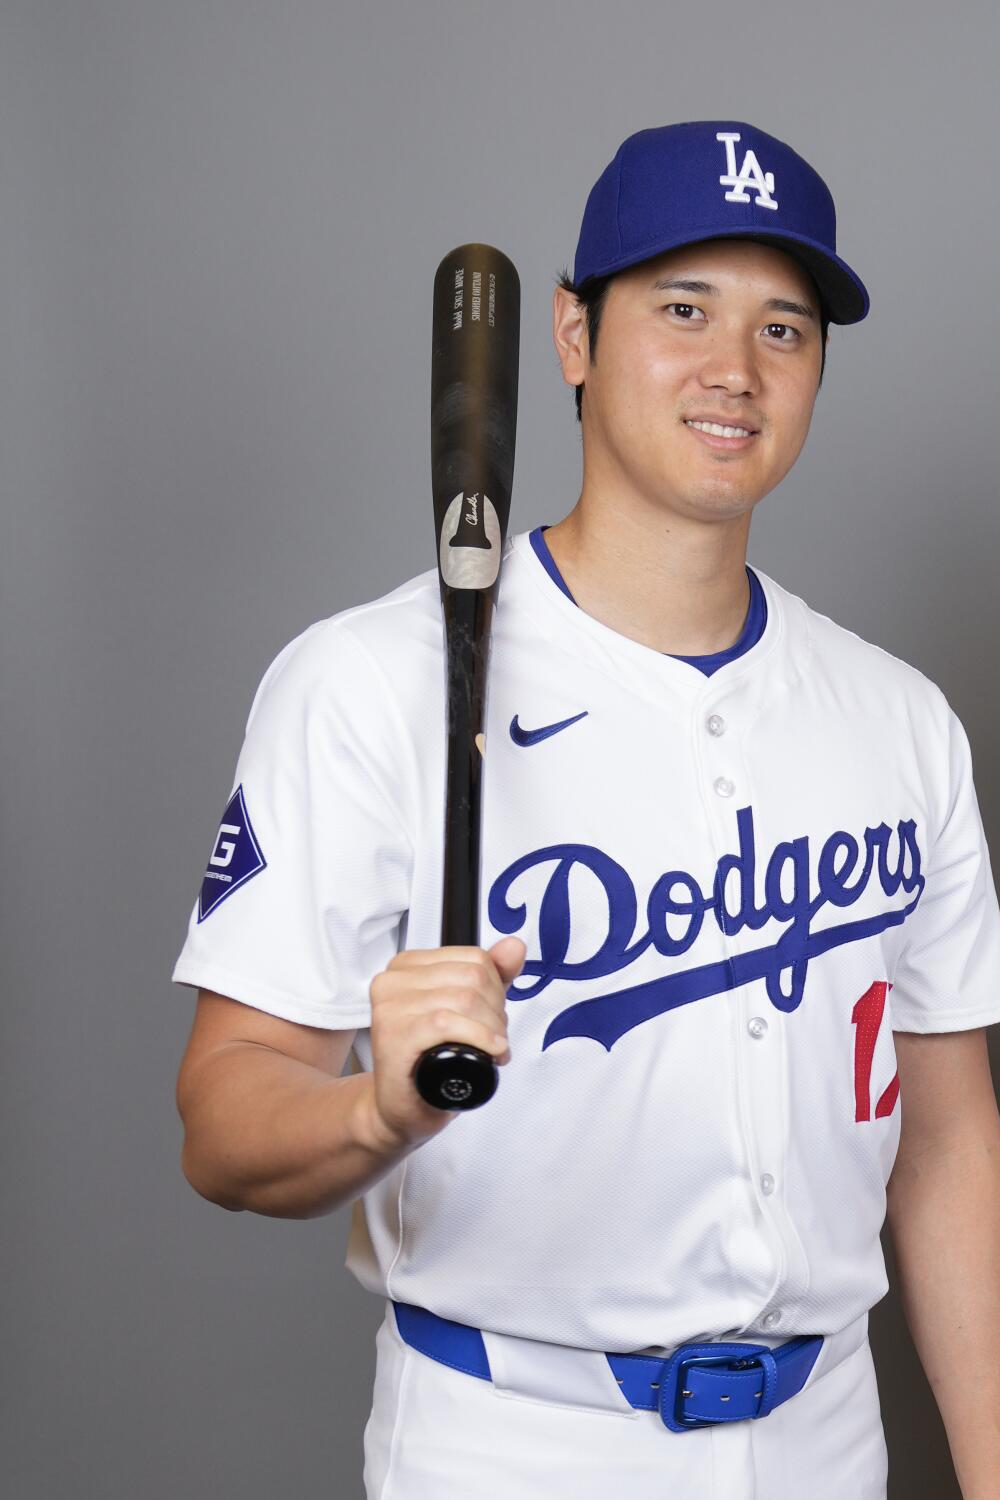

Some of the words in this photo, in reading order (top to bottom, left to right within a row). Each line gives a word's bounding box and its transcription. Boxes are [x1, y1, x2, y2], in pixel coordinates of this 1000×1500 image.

[716, 132, 779, 211] LA
[471, 271, 482, 296] OHTANI
[471, 297, 481, 321] SHOHEI
[209, 823, 241, 867] G
[488, 805, 926, 1014] Dodgers
